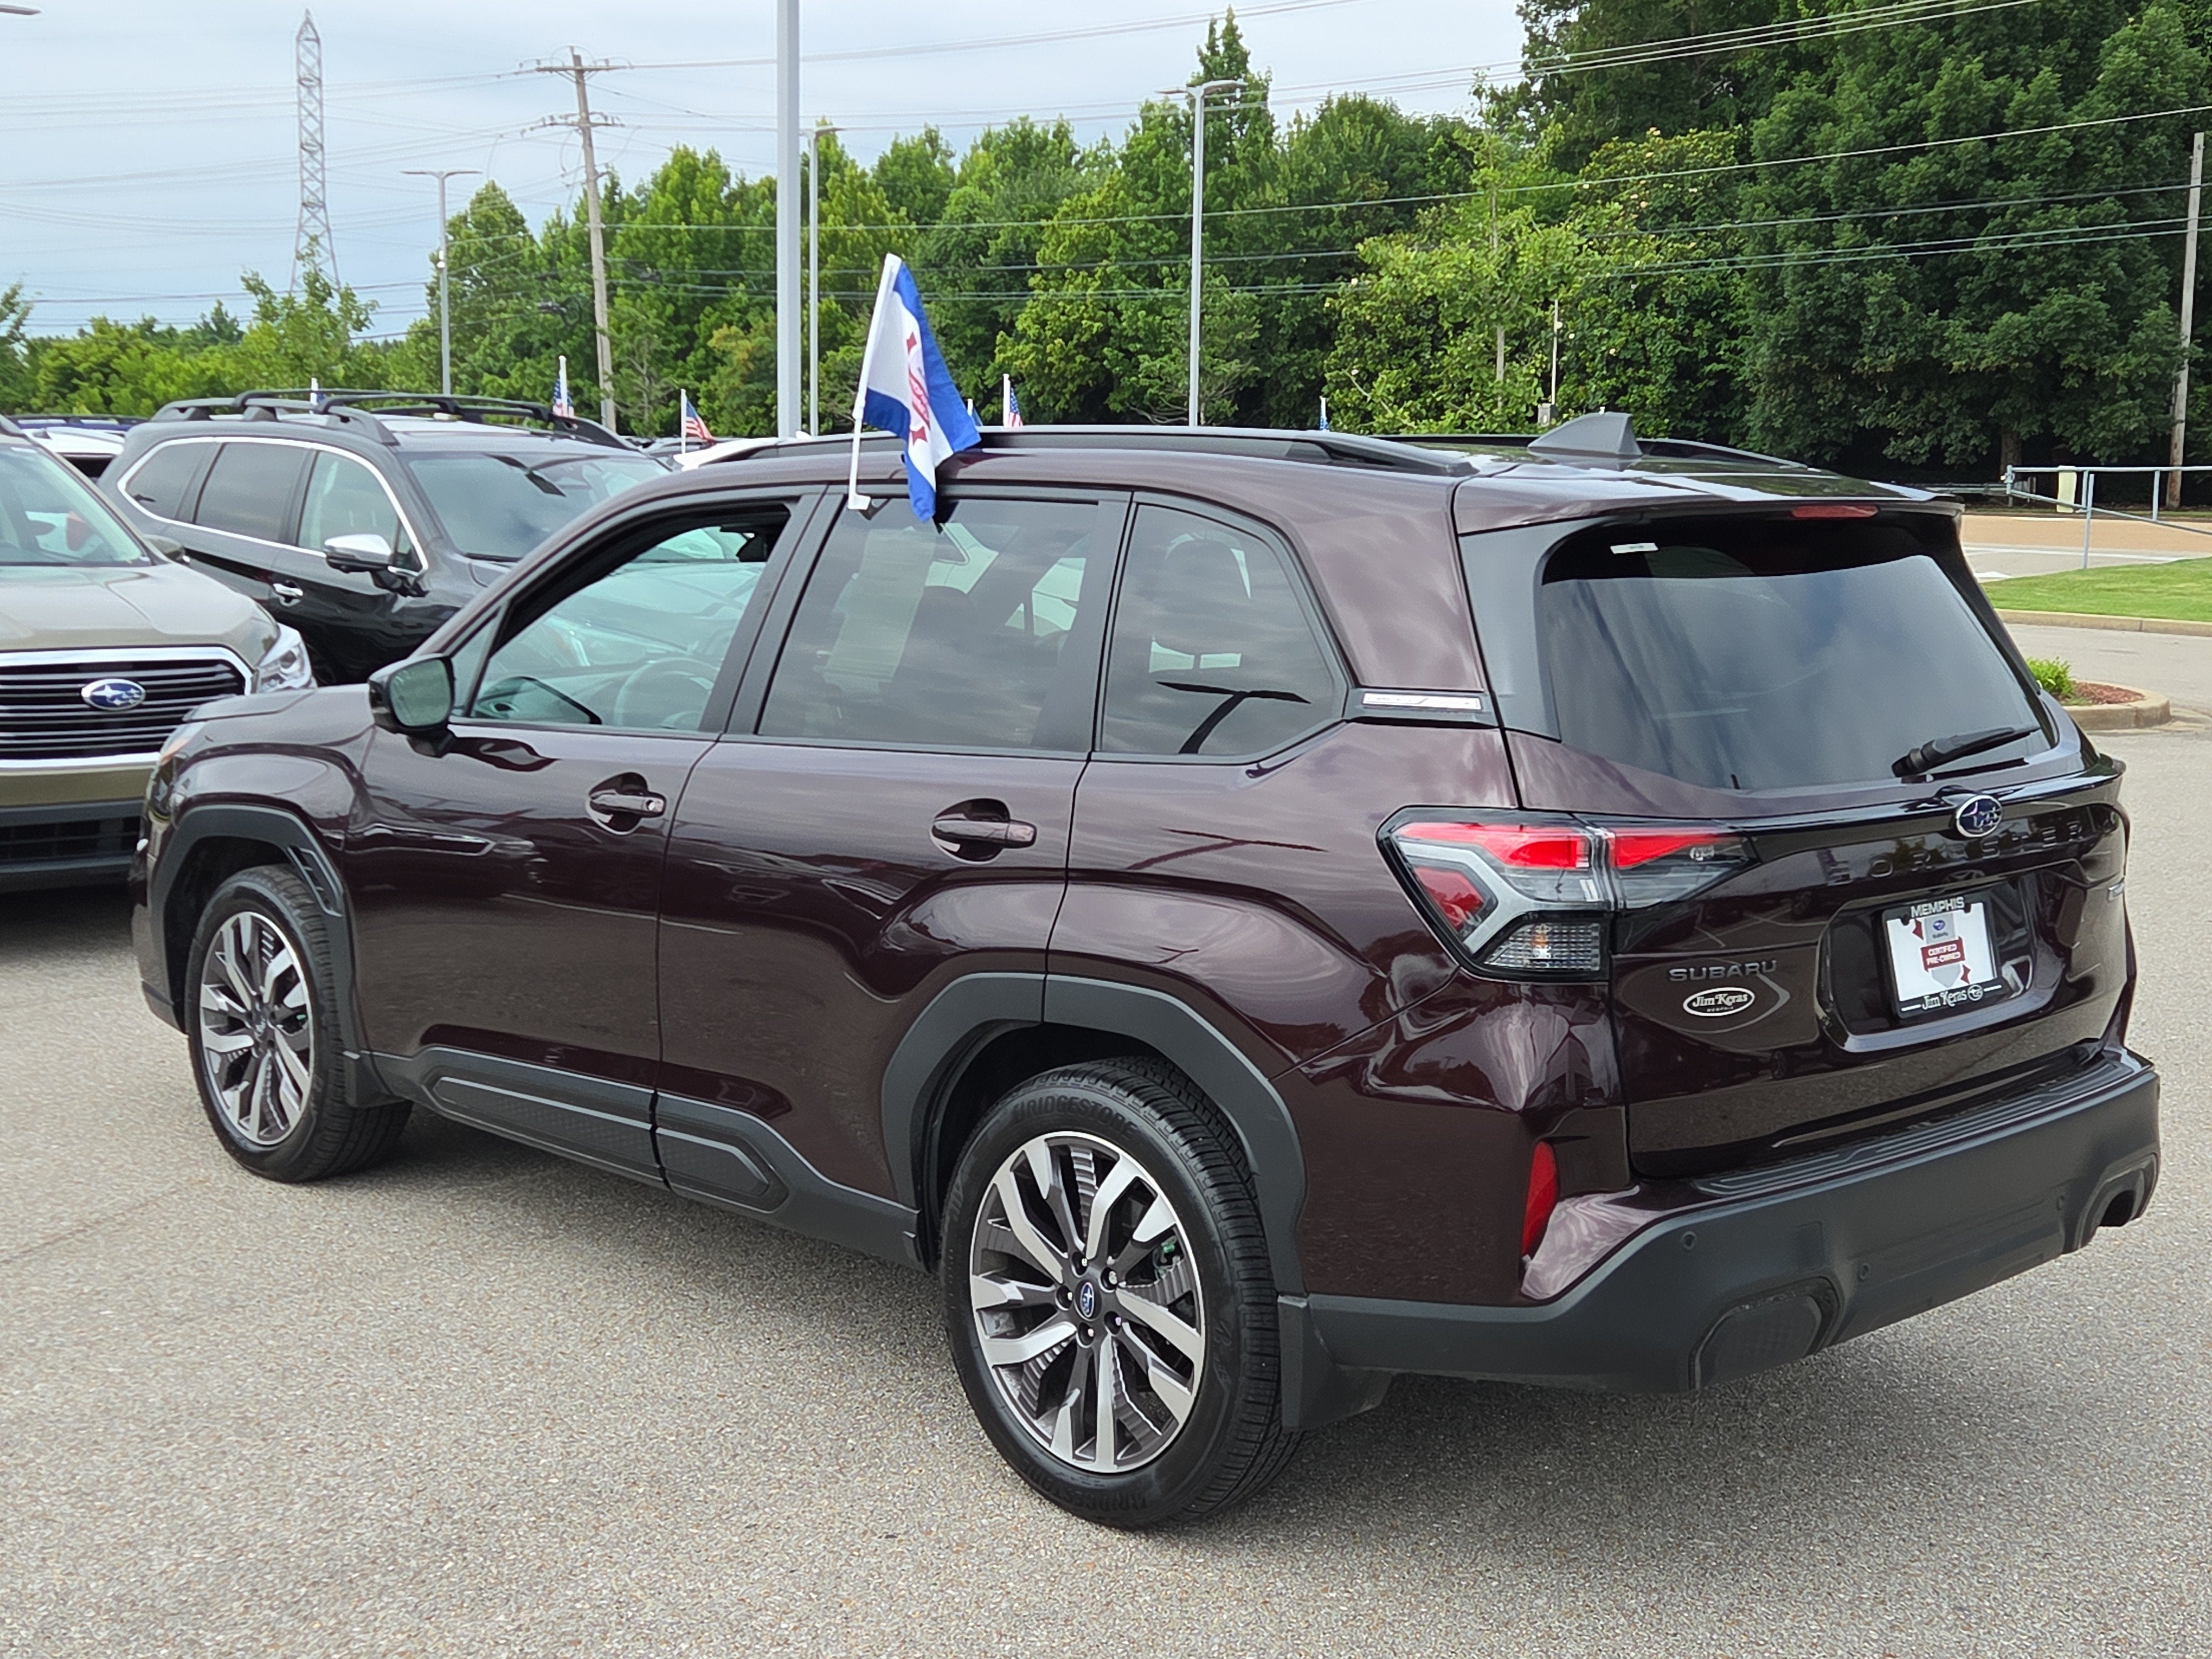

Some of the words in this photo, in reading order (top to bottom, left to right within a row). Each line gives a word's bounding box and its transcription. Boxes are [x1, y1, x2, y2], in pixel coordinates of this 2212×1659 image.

[1910, 896, 1965, 917] MEMPHIS
[1669, 960, 1777, 981] SUBARU
[1692, 996, 1715, 1007] Jim
[1714, 993, 1748, 1006] Keras
[1921, 995, 1941, 1010] Jim
[1939, 989, 1968, 1007] Keras
